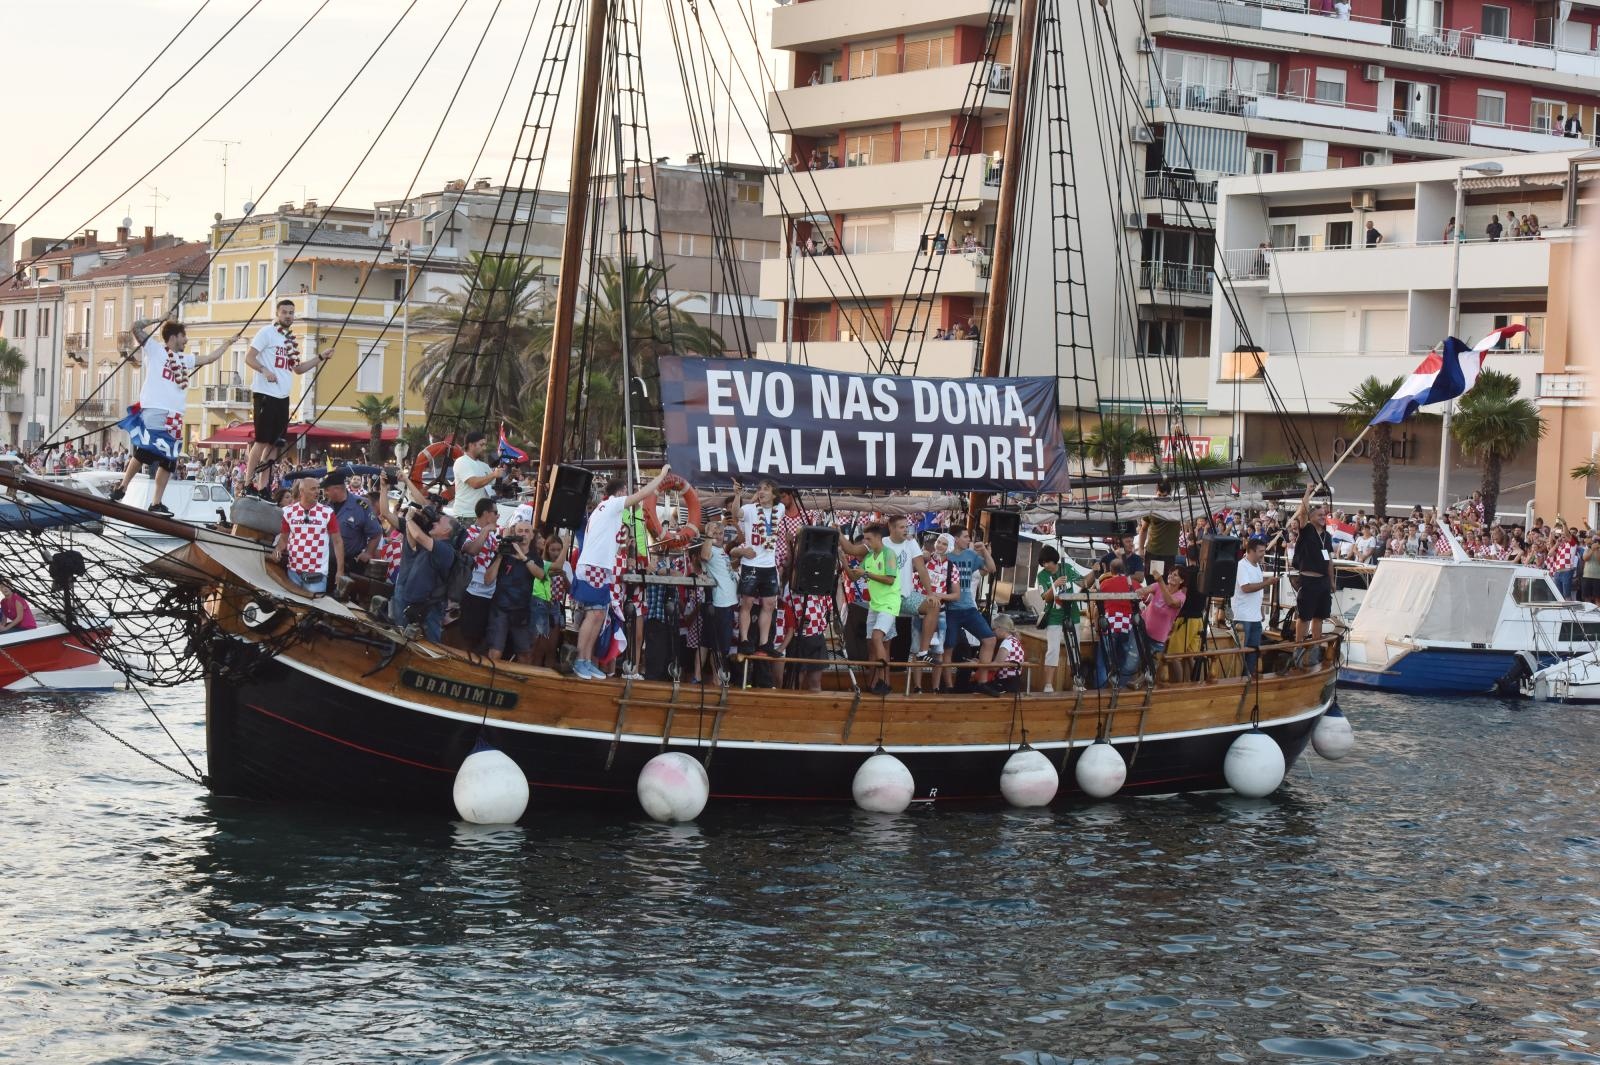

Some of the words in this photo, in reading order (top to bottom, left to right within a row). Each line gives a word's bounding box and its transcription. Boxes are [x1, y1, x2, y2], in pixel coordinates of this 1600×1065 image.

[705, 369, 795, 418] EVO
[810, 374, 899, 422] NAS
[911, 379, 1036, 437] DOMA,
[697, 426, 846, 477] HVALA
[857, 431, 896, 477] TI
[911, 433, 1045, 481] ZADRE!
[415, 675, 504, 705] BRANIMIR
